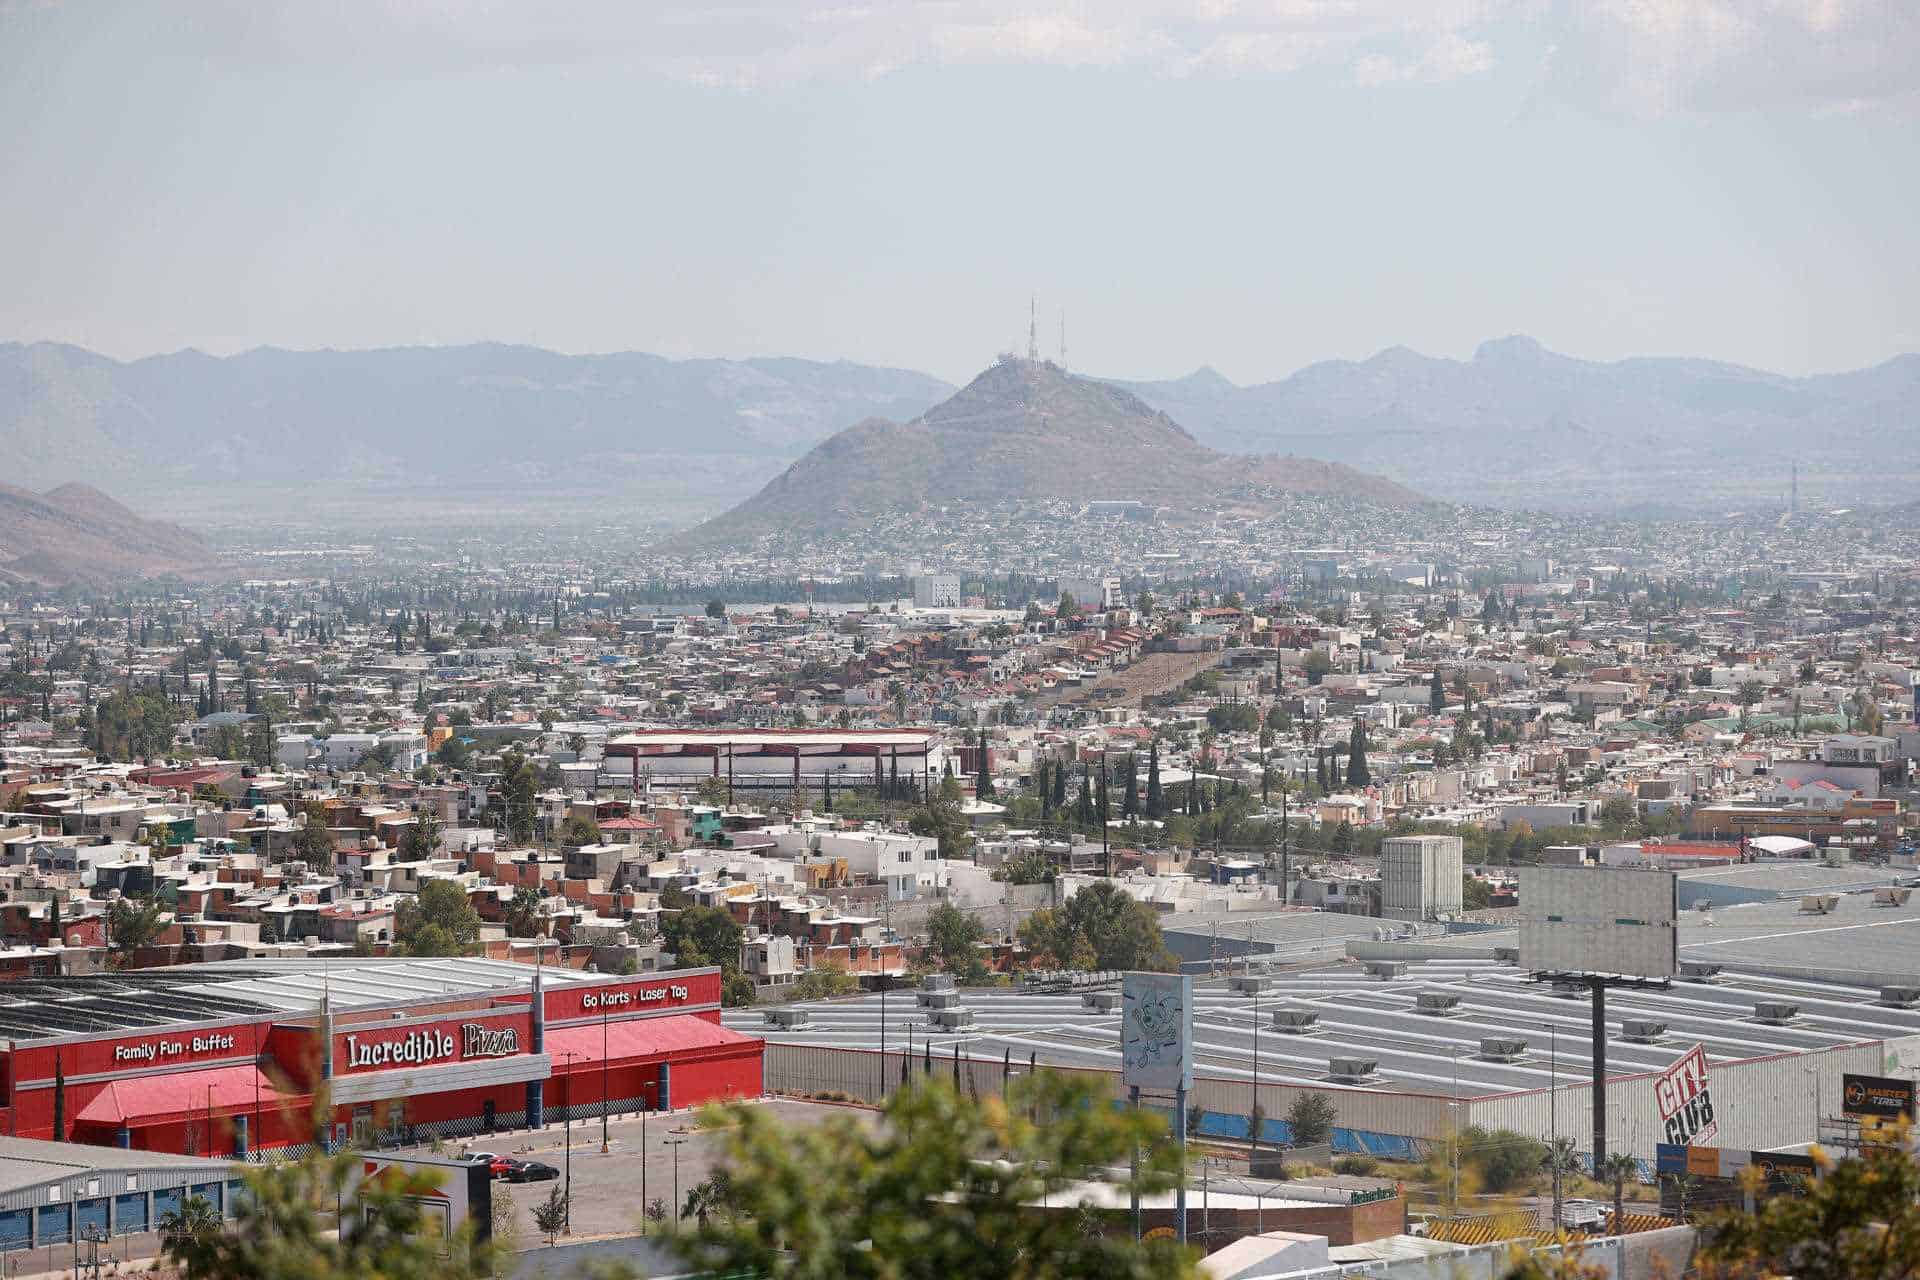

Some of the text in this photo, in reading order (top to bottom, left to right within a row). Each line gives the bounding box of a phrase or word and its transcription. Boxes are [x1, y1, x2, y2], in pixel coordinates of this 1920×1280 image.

[583, 985, 687, 1007] Go Karts Laser Tag
[115, 1034, 234, 1060] Family Fun Buffet
[347, 1024, 519, 1067] Incredible Pizza
[1658, 1055, 1701, 1115] CITY
[1665, 1089, 1713, 1144] CLUB
